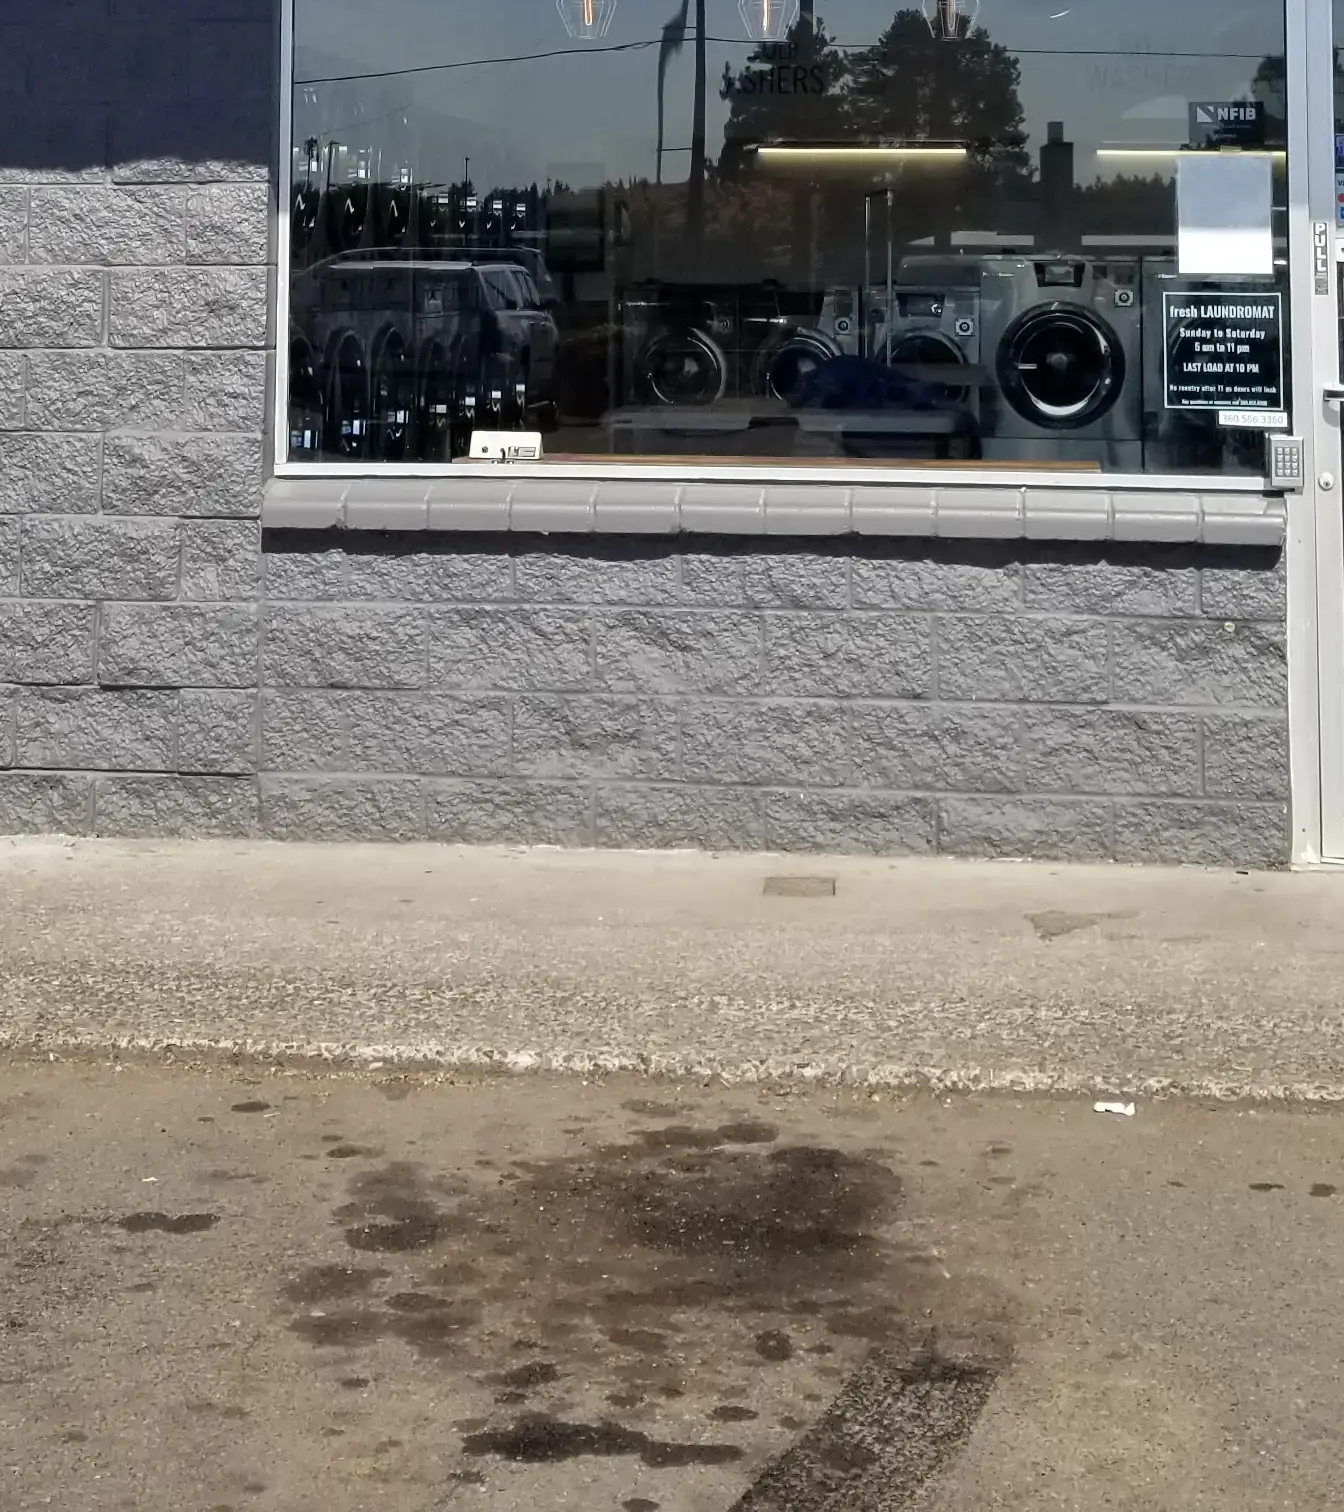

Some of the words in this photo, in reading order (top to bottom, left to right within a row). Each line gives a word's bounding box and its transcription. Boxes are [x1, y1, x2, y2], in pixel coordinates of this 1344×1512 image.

[1217, 107, 1257, 121] NFIB
[1314, 222, 1327, 272] PULL
[1169, 305, 1198, 318] fresh
[1200, 305, 1275, 319] LAUNDROMAT
[1179, 328, 1211, 338] Sunday
[1214, 329, 1223, 338] to
[1225, 328, 1265, 339] Saturday
[1216, 343, 1225, 352] to
[1227, 343, 1235, 352] 11
[1183, 363, 1201, 372] LAST
[1203, 363, 1223, 372] LOAD
[1225, 363, 1234, 372] AT
[1235, 363, 1245, 372] 10
[1246, 364, 1260, 373] PM
